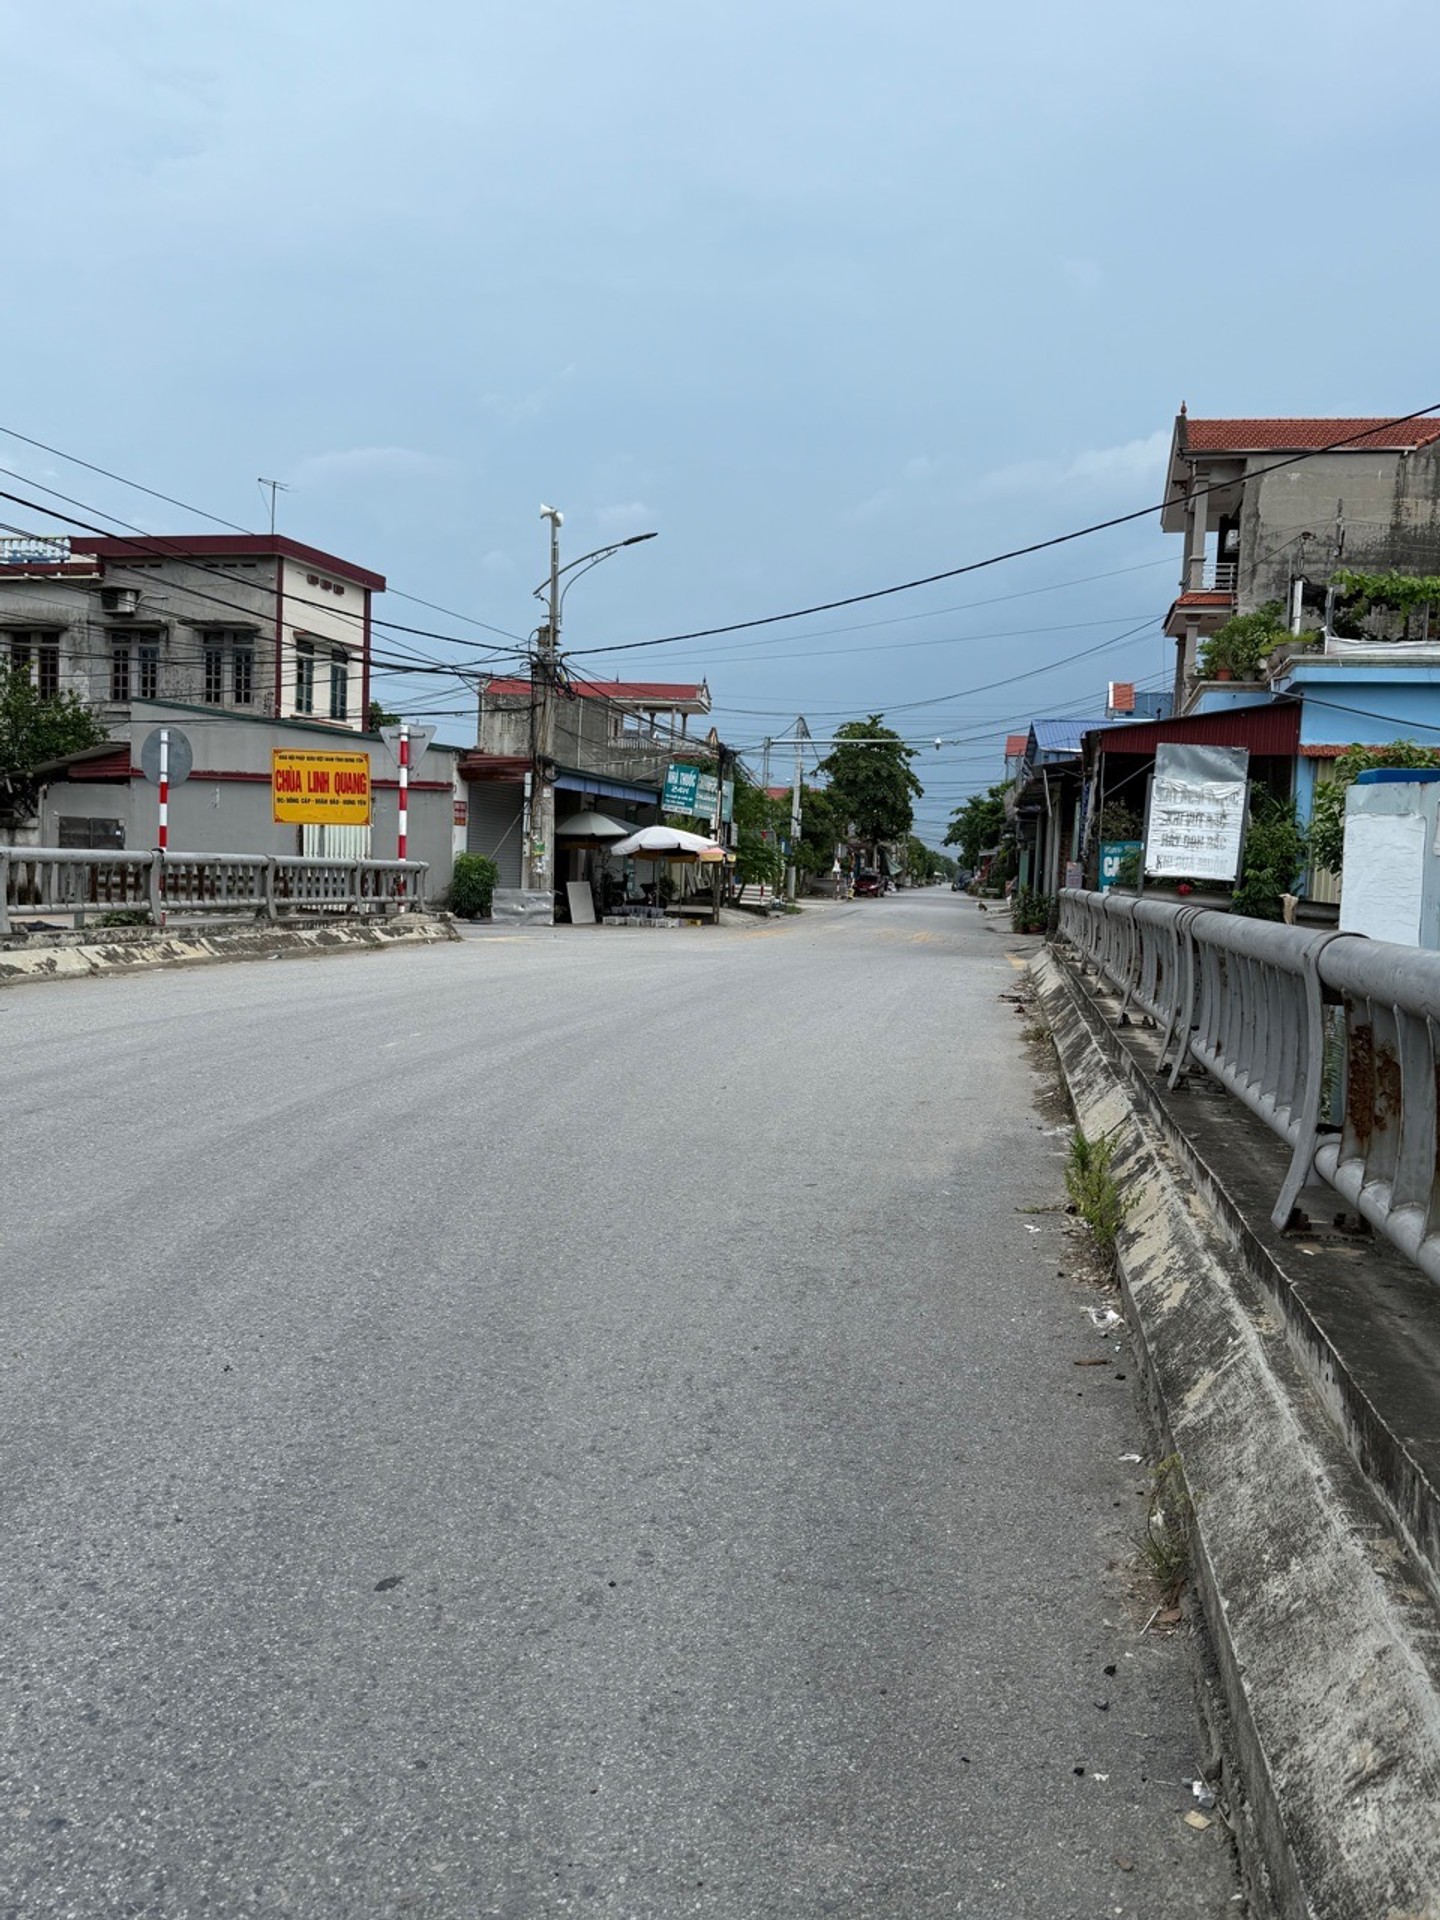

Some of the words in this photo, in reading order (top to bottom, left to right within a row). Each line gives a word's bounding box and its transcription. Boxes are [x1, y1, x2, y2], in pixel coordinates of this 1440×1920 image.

[275, 765, 302, 793] CHÙA
[308, 771, 329, 794] LINH
[335, 772, 367, 796] QUANG
